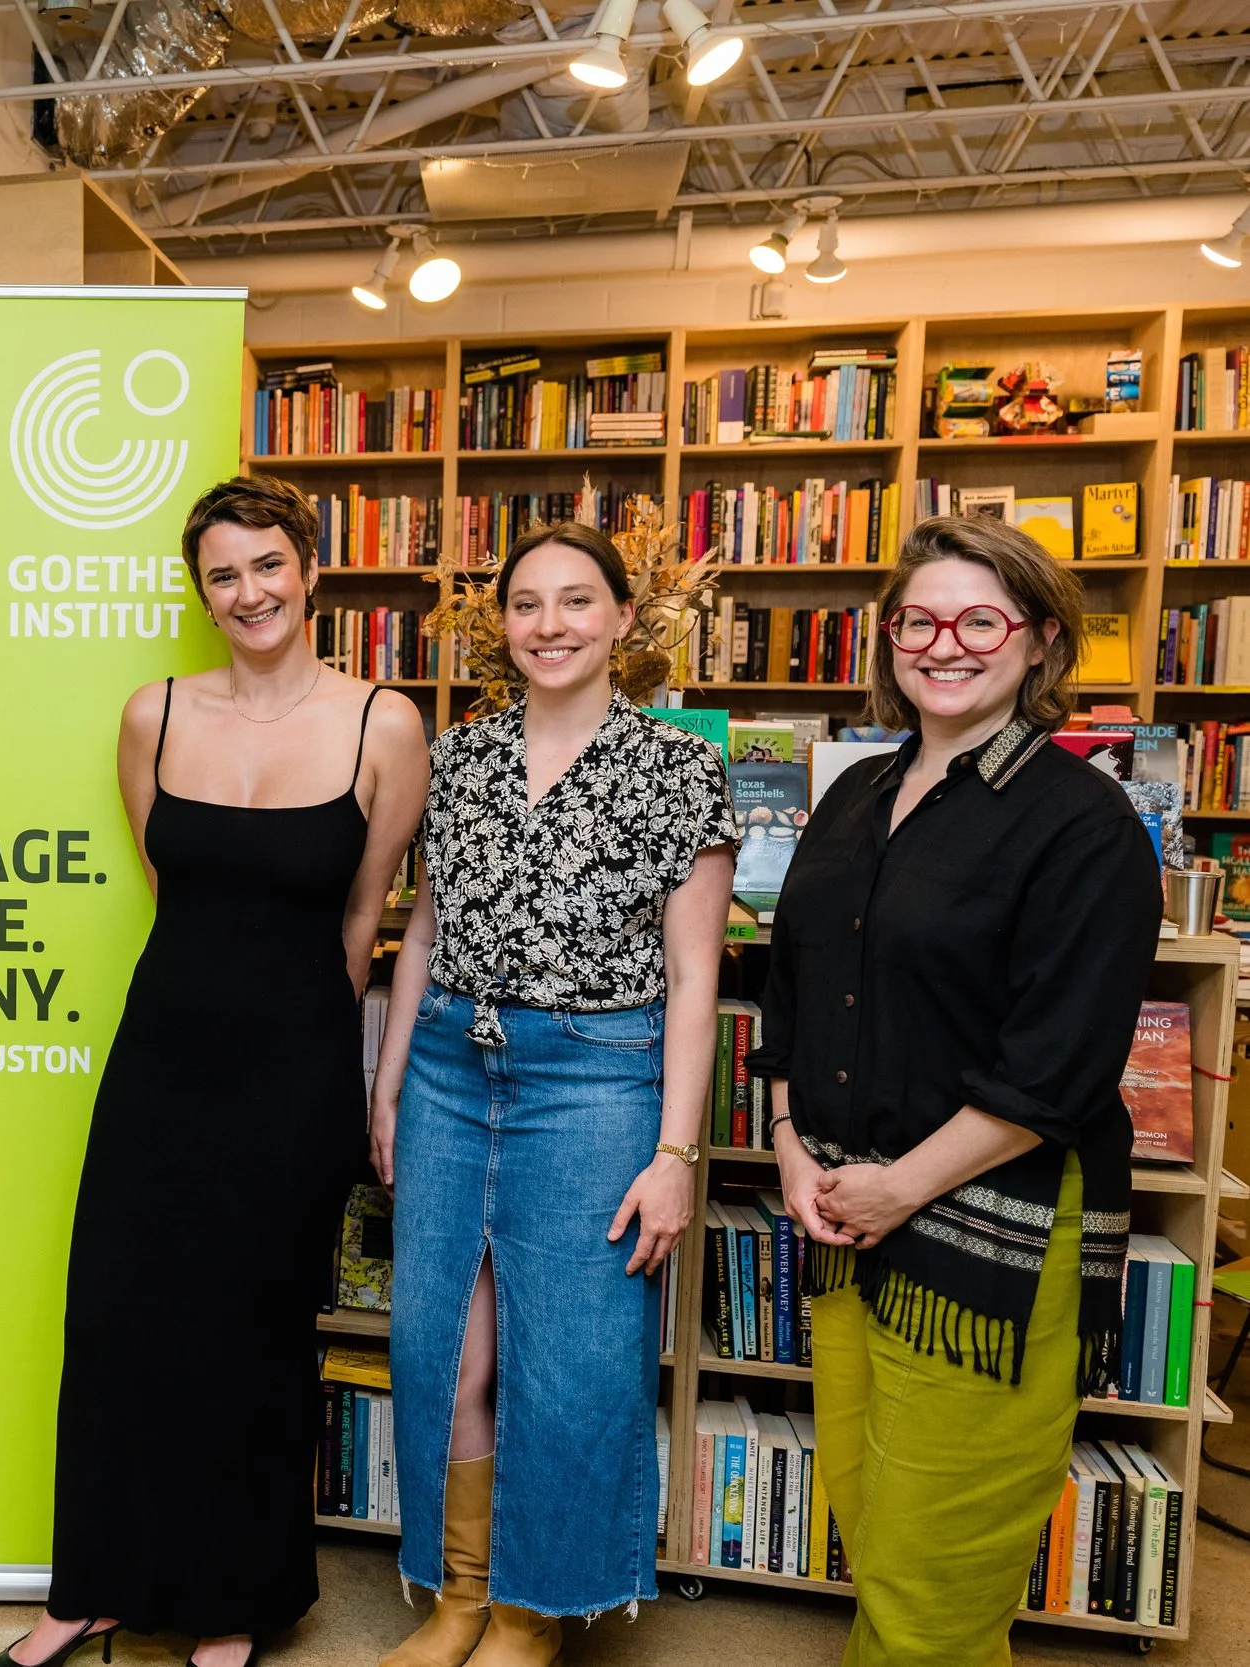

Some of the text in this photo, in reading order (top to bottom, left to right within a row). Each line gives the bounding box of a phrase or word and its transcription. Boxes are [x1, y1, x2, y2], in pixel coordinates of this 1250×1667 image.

[1088, 486, 1136, 501] Martyr!
[8, 554, 186, 592] GOETHE
[10, 602, 186, 638] INSTITUT
[1134, 740, 1159, 751] EIN
[736, 780, 765, 789] Texas
[736, 788, 785, 799] Seashells
[736, 1020, 748, 1105] COYOTE AMERICA
[780, 1221, 788, 1231] IS
[716, 1234, 724, 1282] DISPERSALS
[760, 1240, 770, 1251] H
[780, 1244, 788, 1274] RIVER
[742, 1264, 752, 1282] Flights
[719, 1290, 728, 1318] JESSICA
[780, 1276, 788, 1312] ALIVE?
[746, 1319, 754, 1346] Macdonald
[763, 1322, 771, 1348] Macdonald
[340, 1390, 350, 1472] WE ARE NATURE
[776, 1460, 784, 1478] Light
[728, 1456, 741, 1514] THE QUICKENING
[760, 1481, 768, 1526] ENTANGLED
[1111, 1494, 1120, 1520] SWAMP
[1126, 1496, 1138, 1530] Following
[745, 1506, 753, 1550] RESERVOIRS
[1092, 1489, 1106, 1582] Fundamentals Frank Wilczek
[1128, 1532, 1137, 1545] the
[1150, 1524, 1161, 1558] The Earth
[1126, 1546, 1136, 1566] Bend
[1164, 1494, 1179, 1623] CARL ZIMMER LIFE'S EDGE
